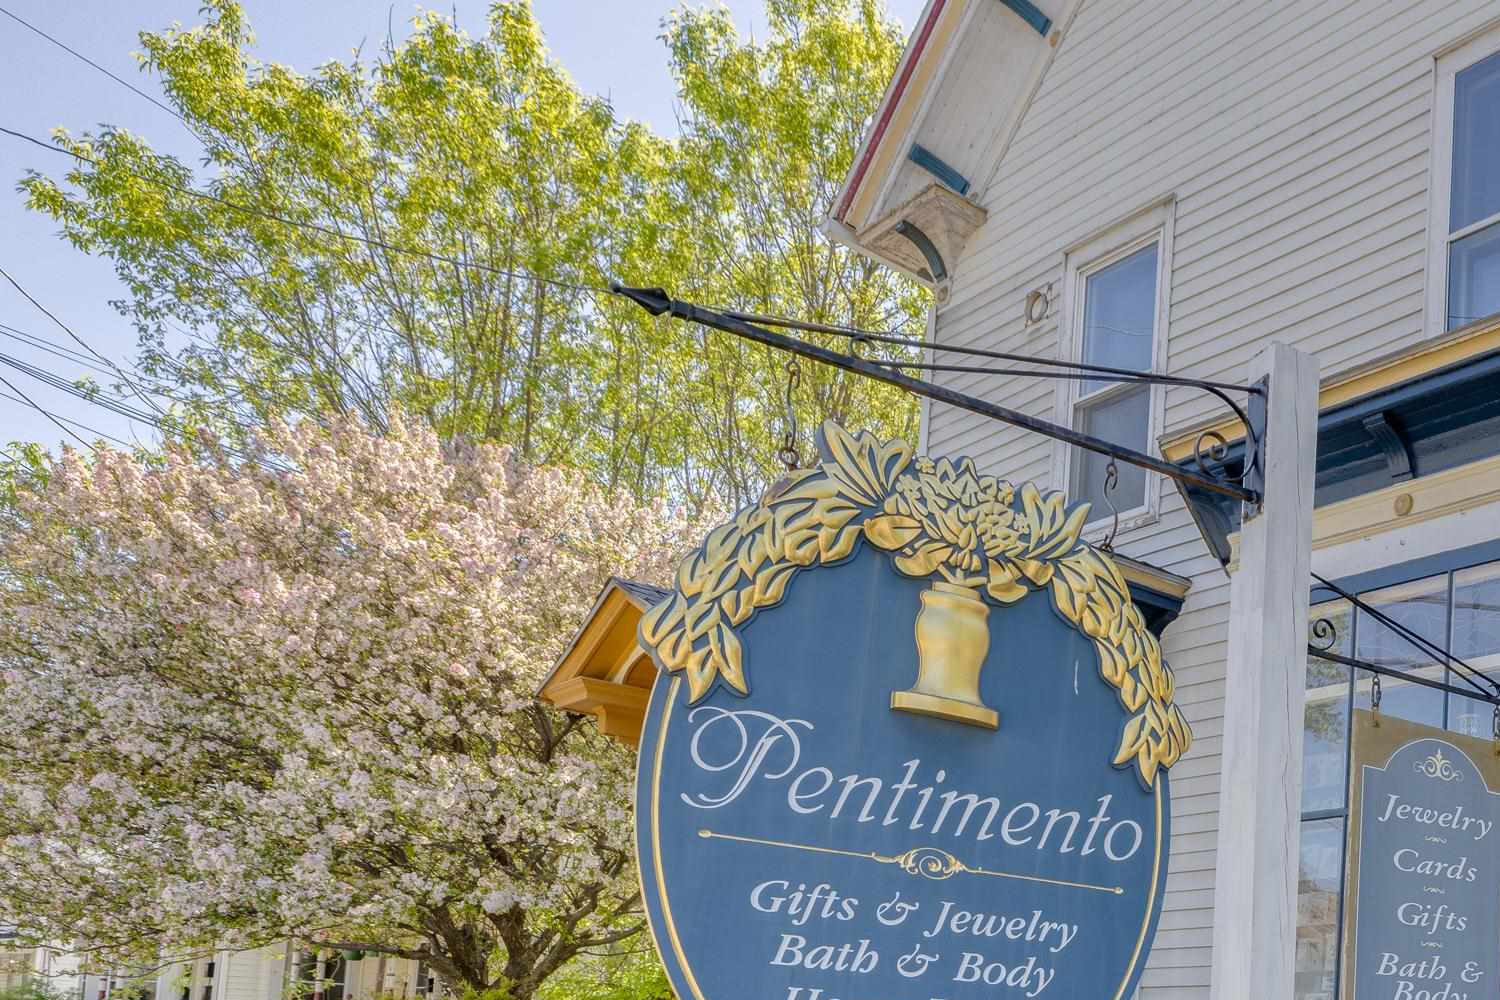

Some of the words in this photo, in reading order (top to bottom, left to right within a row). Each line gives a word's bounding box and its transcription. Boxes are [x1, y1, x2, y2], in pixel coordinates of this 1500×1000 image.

[681, 706, 1143, 862] Pentimento
[1378, 793, 1492, 840] Jewelry
[1393, 848, 1478, 882] Cards
[750, 879, 859, 926] Gifts
[876, 892, 919, 926] &
[924, 900, 1078, 952] Jewelry
[1397, 902, 1468, 935] Gifts
[769, 934, 879, 974] Bath
[896, 944, 940, 978] &
[953, 951, 1055, 998] Body
[1376, 952, 1446, 980] Bath
[1460, 961, 1484, 983] &
